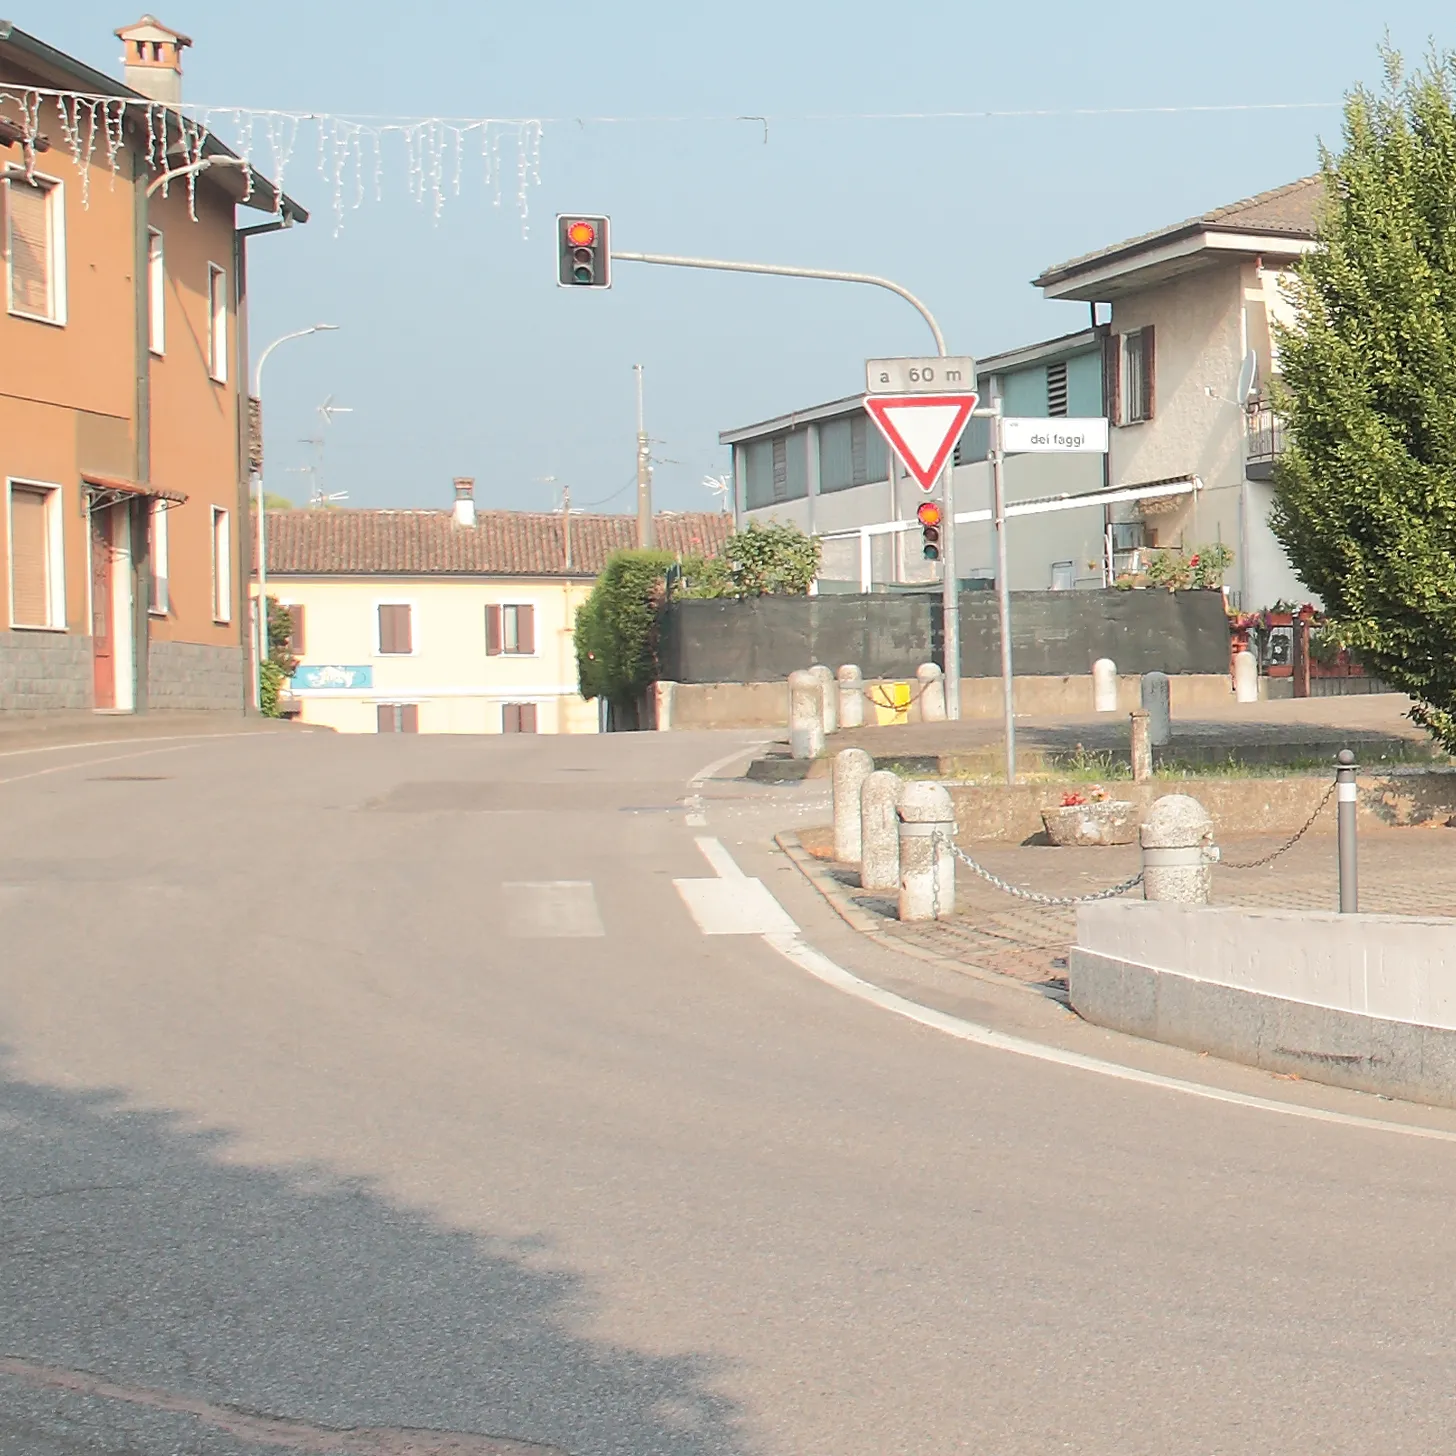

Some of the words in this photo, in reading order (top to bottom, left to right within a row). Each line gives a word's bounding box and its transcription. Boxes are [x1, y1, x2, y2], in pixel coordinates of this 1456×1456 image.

[880, 372, 889, 383] a
[909, 367, 934, 382] 60
[945, 370, 961, 381] m
[1030, 433, 1049, 444] dei
[1053, 433, 1085, 447] faggi
